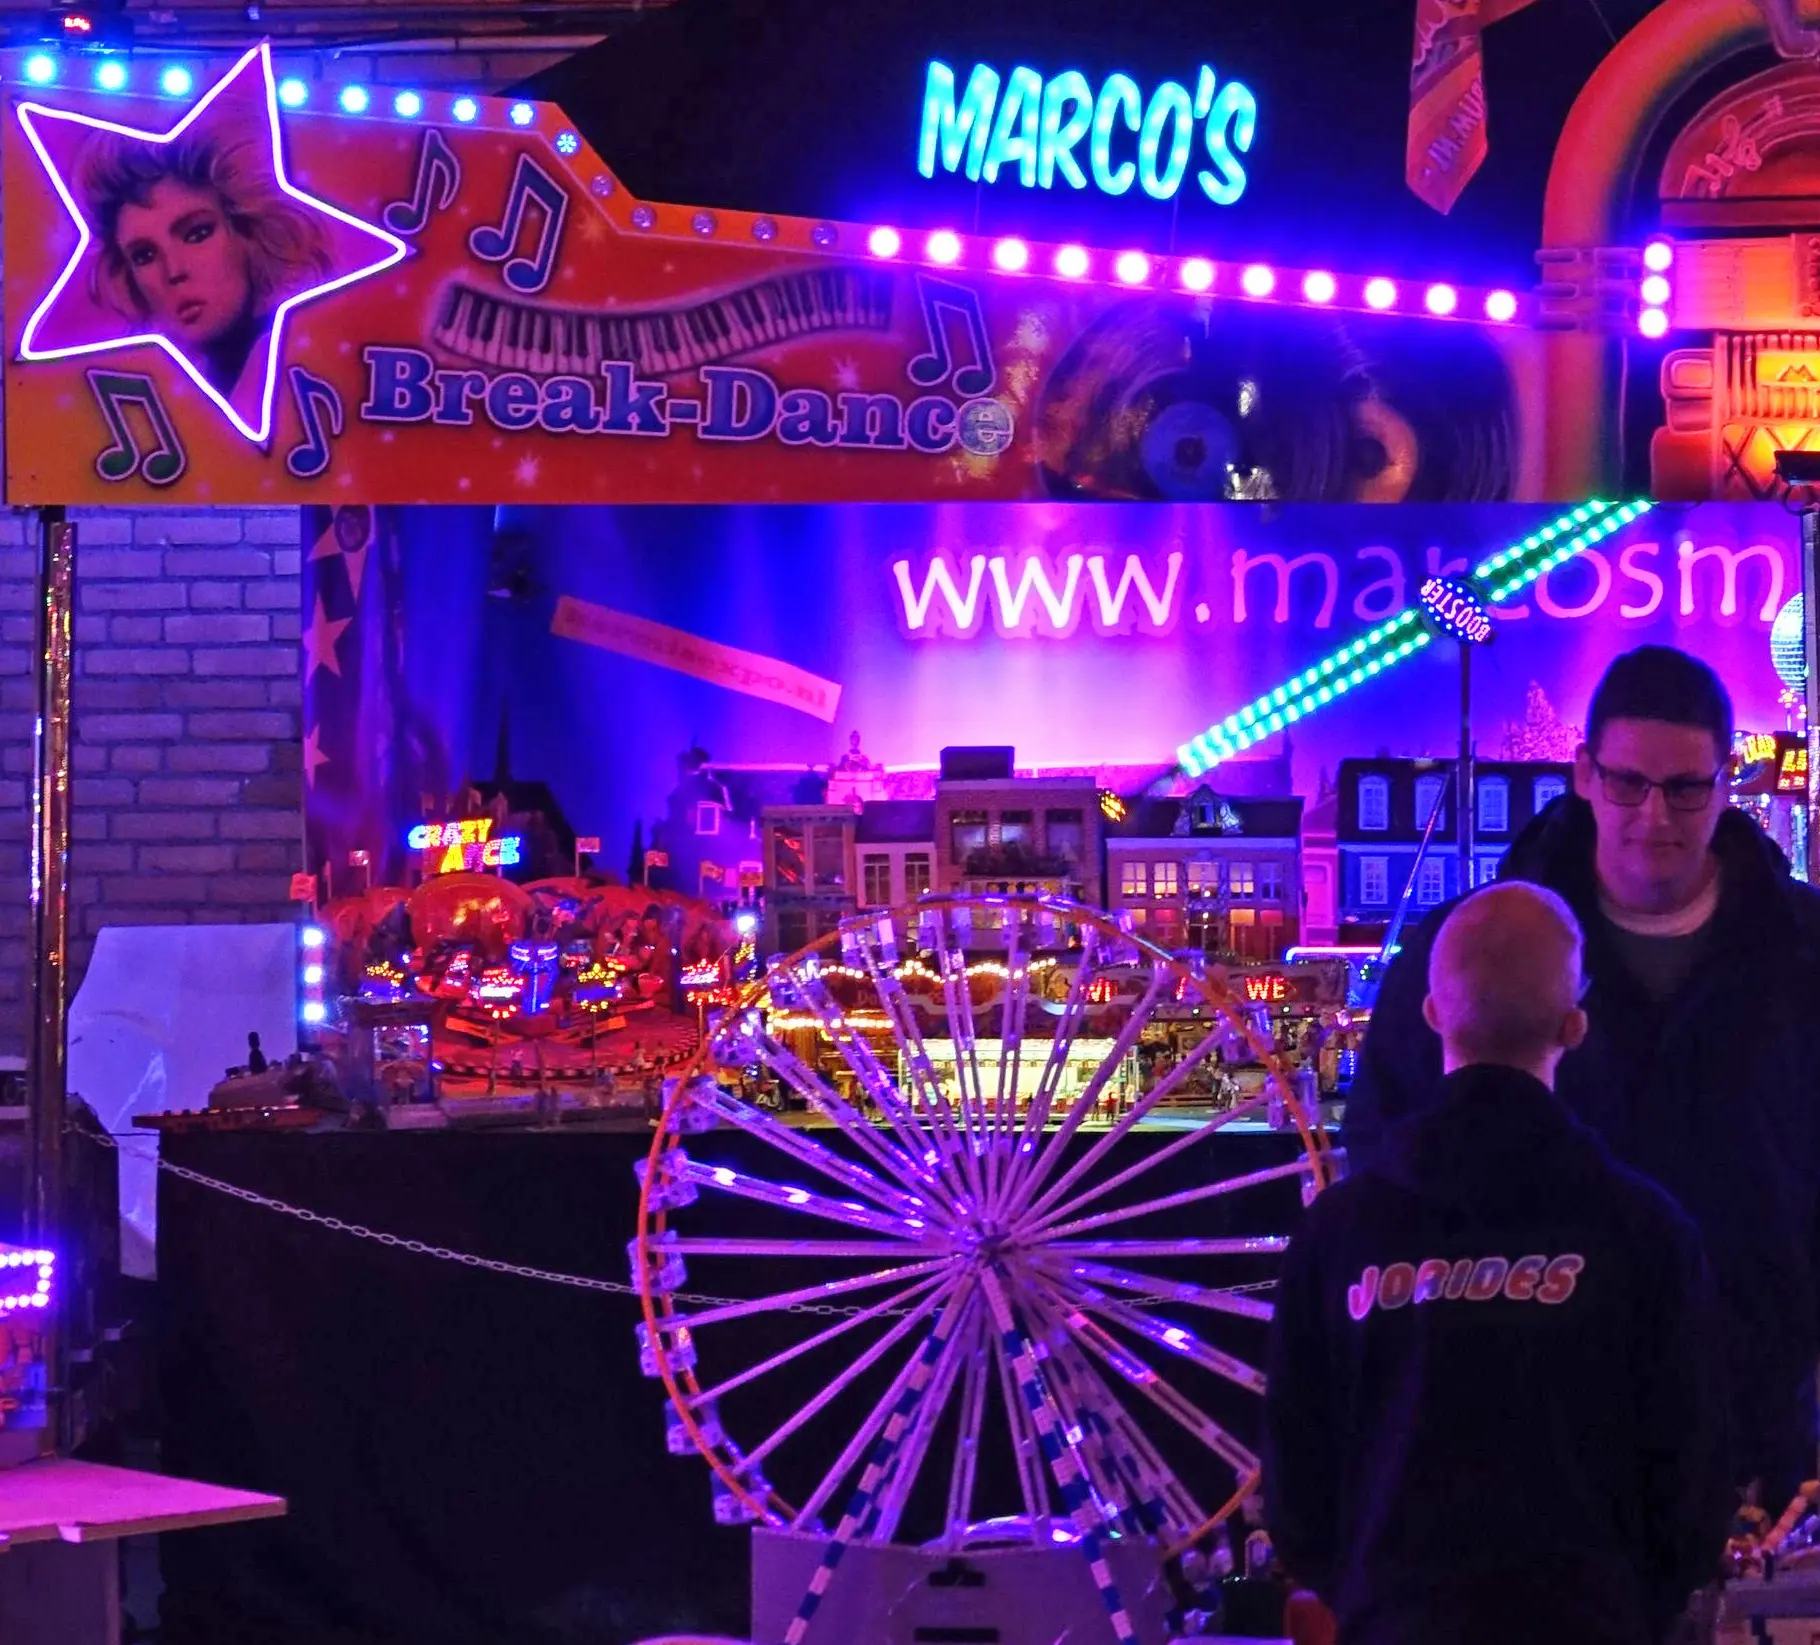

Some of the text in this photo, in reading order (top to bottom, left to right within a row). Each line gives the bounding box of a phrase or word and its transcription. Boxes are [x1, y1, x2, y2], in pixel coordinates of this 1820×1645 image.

[917, 60, 1257, 206] MARCO'S
[361, 345, 1014, 456] Break-Dance
[1420, 578, 1491, 641] BOOSTER
[407, 817, 493, 850] CRAZY
[1347, 1252, 1586, 1321] JORIDES
